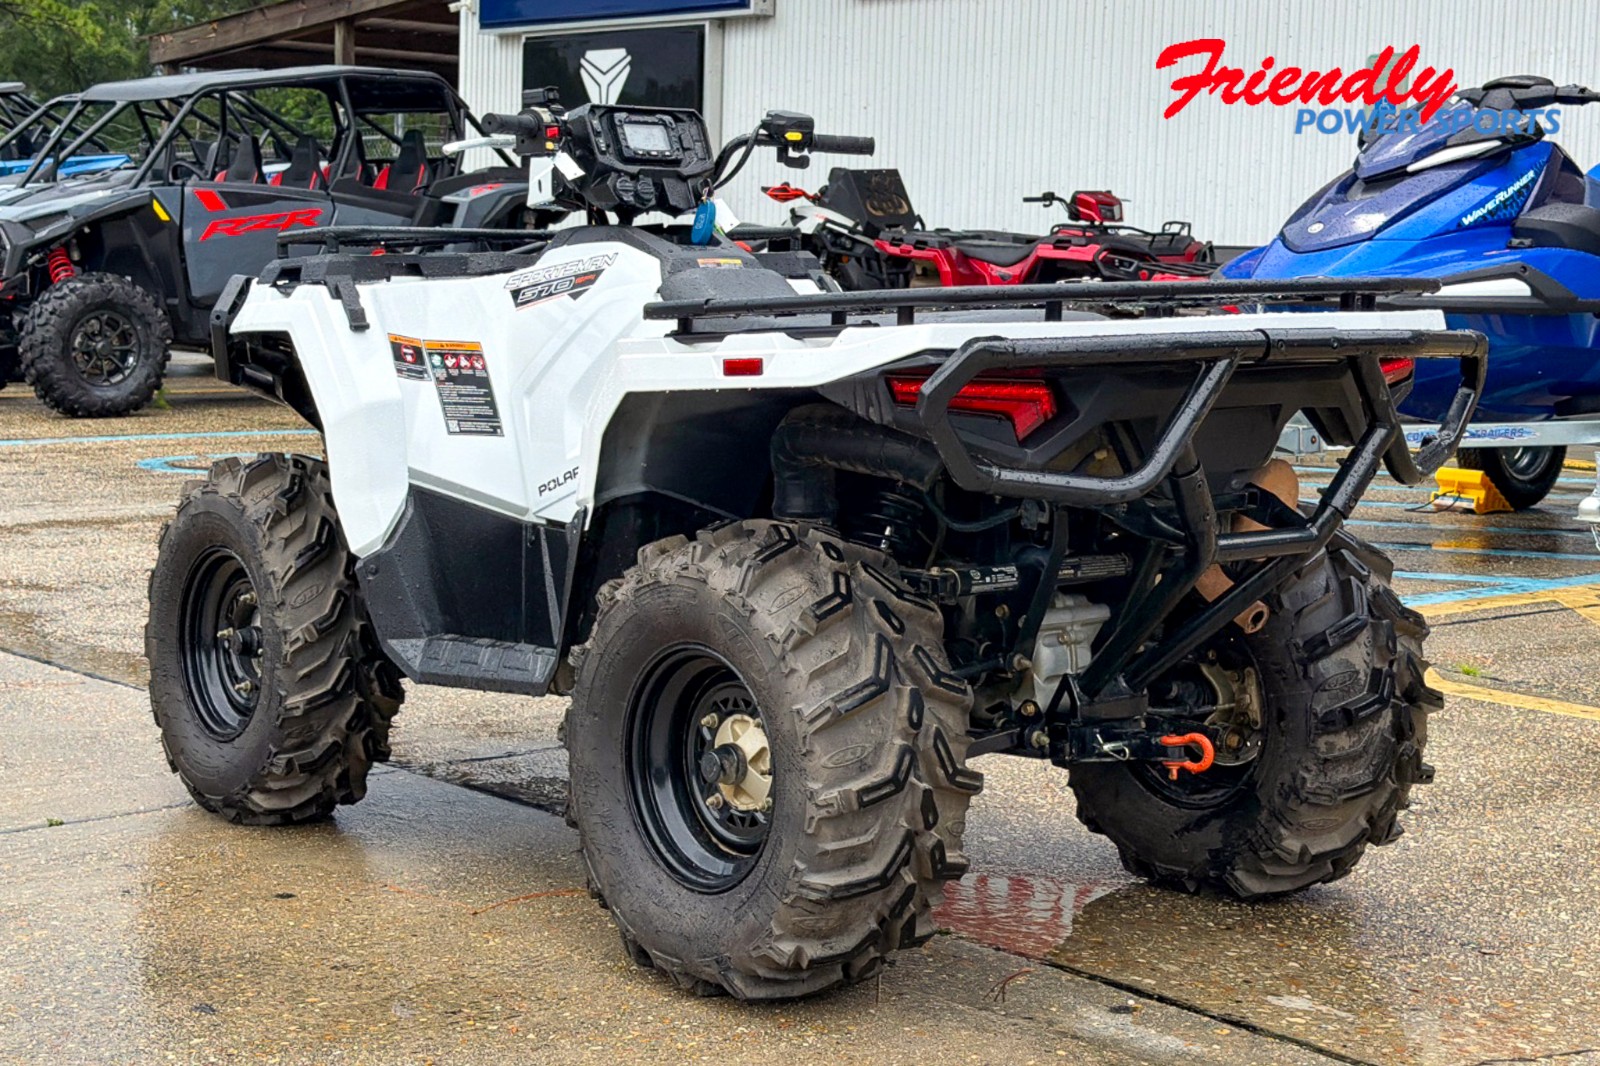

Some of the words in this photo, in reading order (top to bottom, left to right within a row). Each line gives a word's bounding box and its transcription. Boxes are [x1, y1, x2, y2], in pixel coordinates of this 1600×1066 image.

[198, 208, 323, 242] RZR
[503, 252, 619, 289] SPORTSMAN
[517, 276, 575, 303] 570
